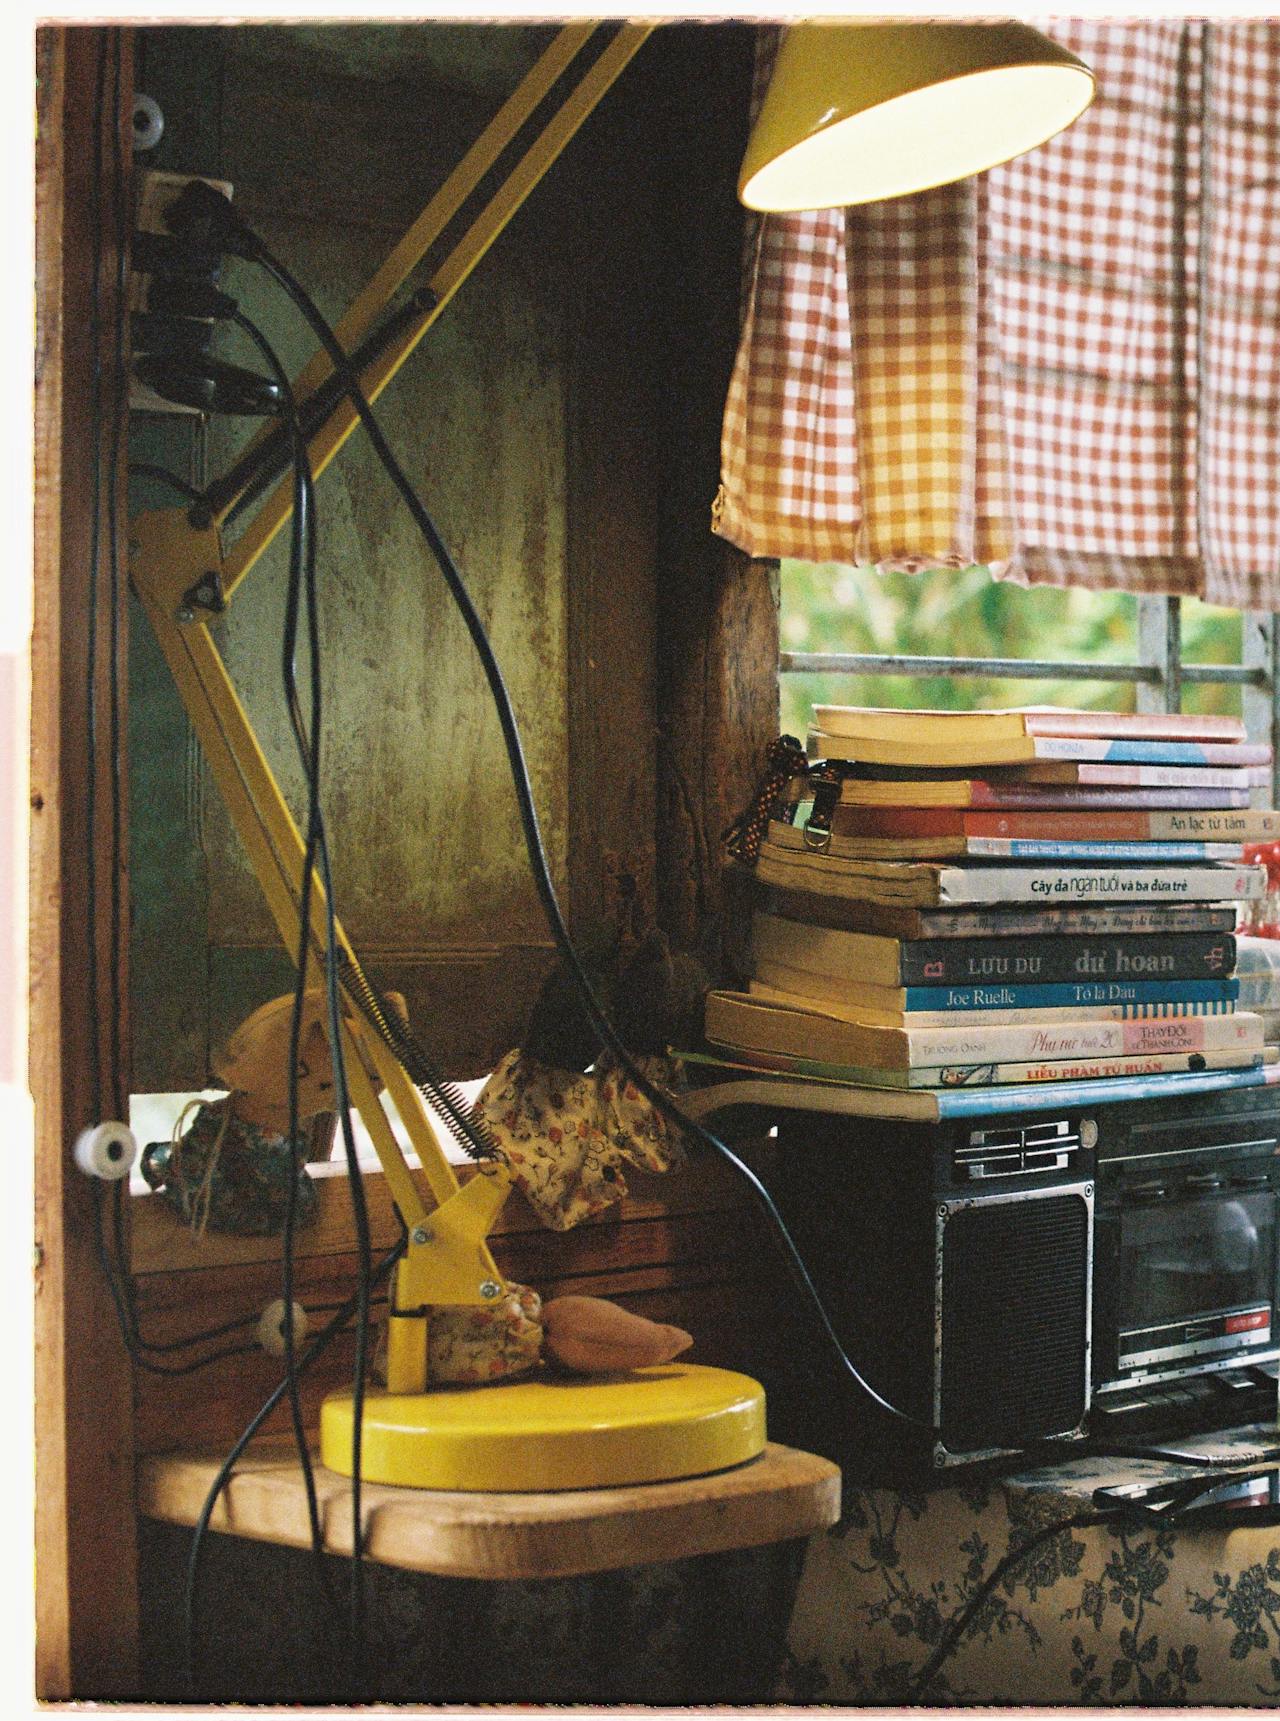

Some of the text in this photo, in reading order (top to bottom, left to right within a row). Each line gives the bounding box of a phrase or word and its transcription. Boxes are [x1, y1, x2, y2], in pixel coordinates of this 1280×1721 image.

[1171, 815, 1186, 830] An
[1054, 878, 1069, 892] đa
[1135, 880, 1149, 892] ba
[1115, 948, 1175, 972] hoan
[946, 988, 1017, 1006] Joe Ruelle
